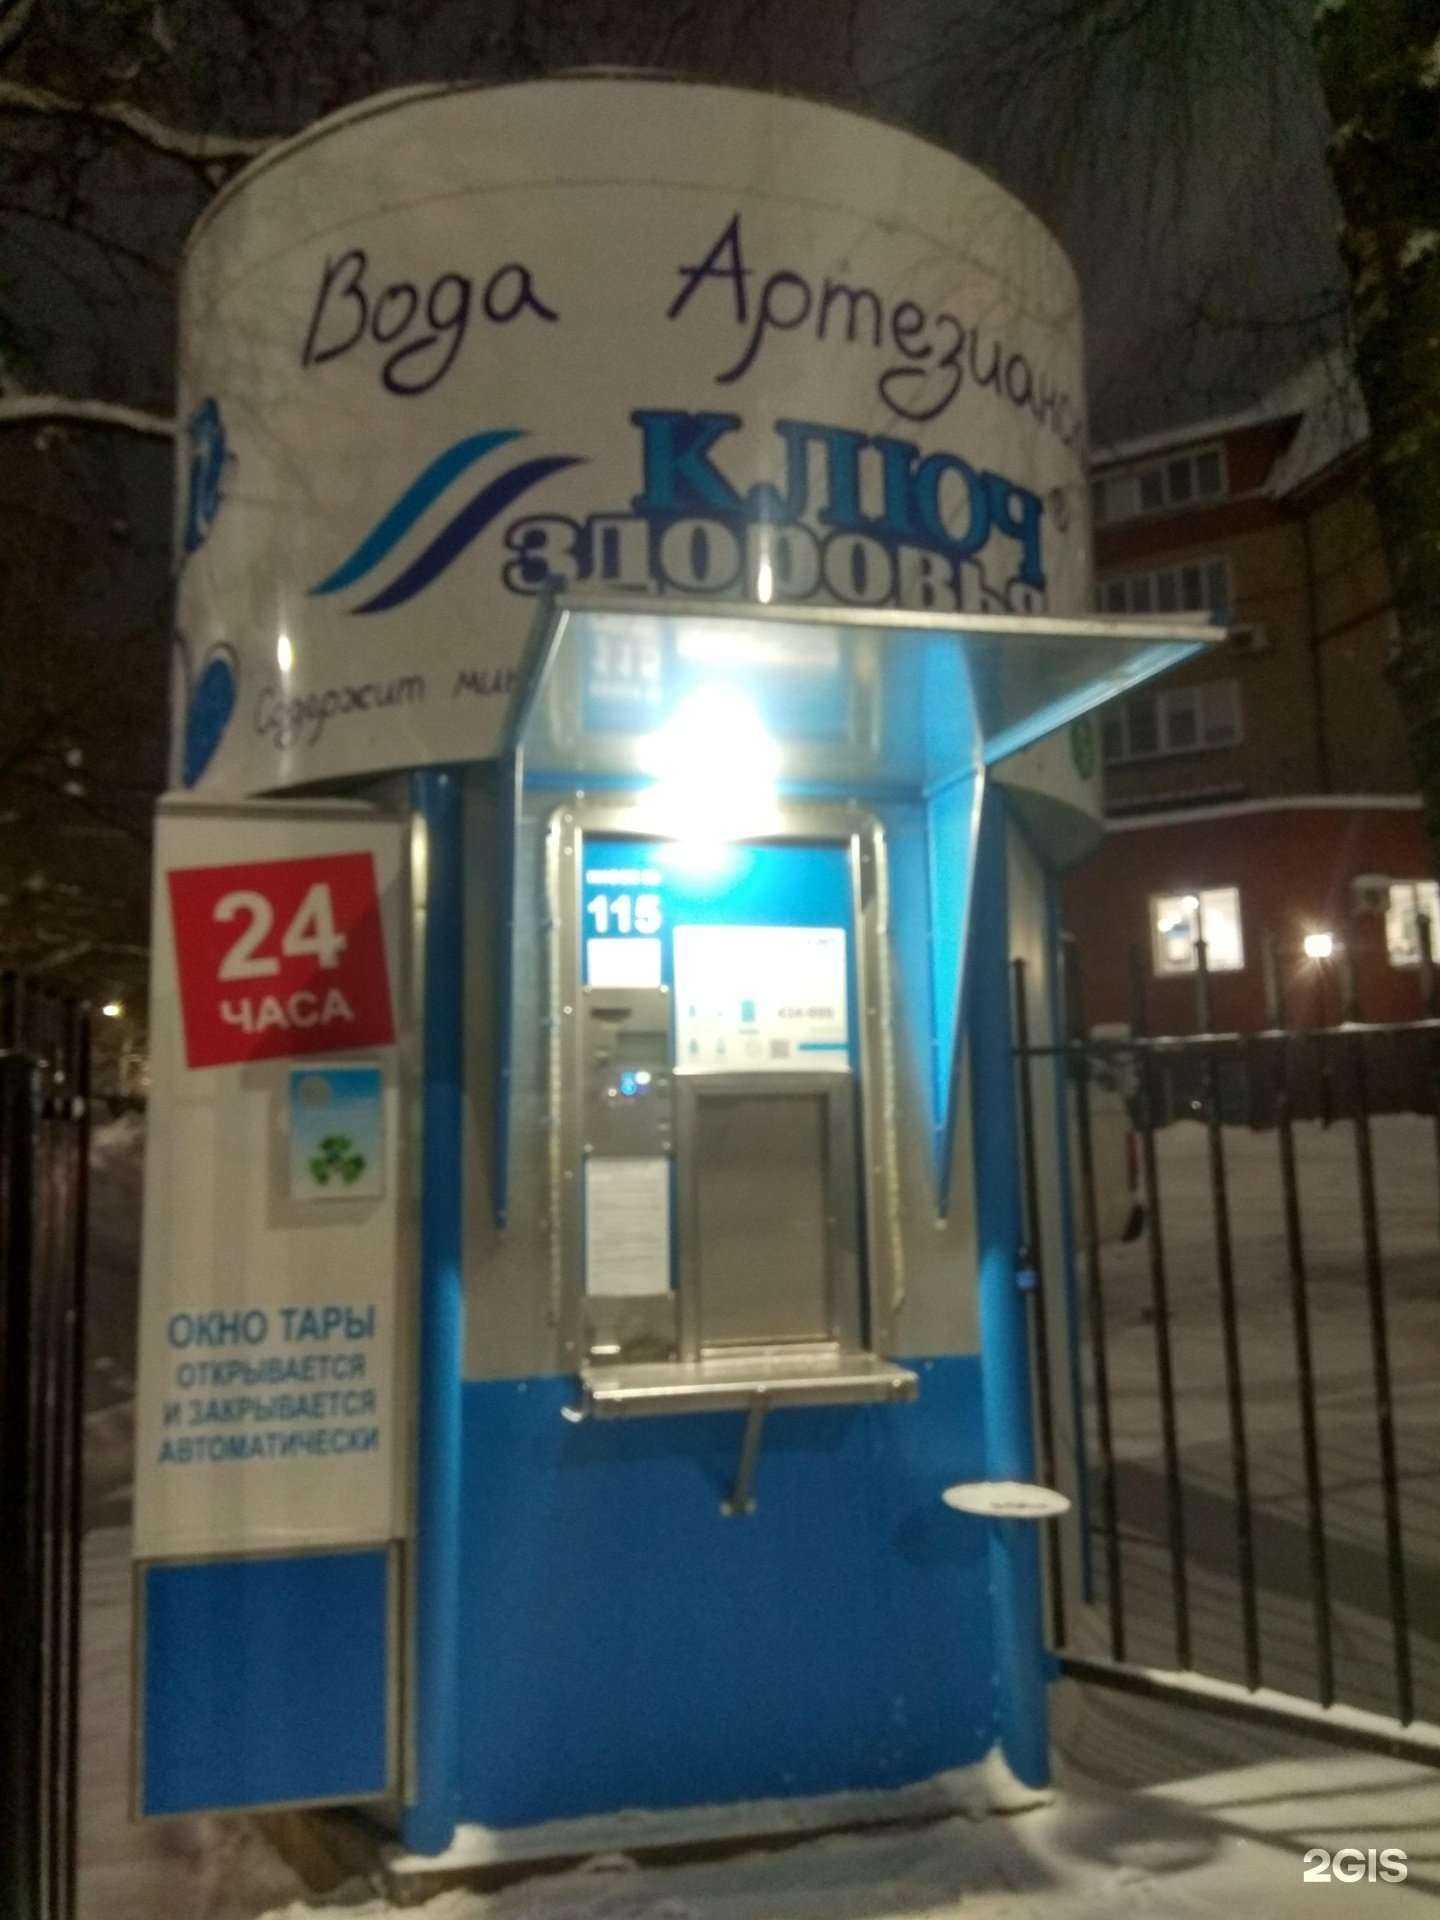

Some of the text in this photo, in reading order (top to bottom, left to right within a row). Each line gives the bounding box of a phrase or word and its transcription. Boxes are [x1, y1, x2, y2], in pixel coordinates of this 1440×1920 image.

[303, 248, 560, 397] Вода
[630, 408, 1046, 588] КЛЮЧ
[213, 882, 349, 983] 24
[587, 893, 663, 934] 115
[219, 988, 355, 1034] ЧАСА
[168, 1304, 376, 1348] ОКНО ТАРЫ
[176, 1353, 367, 1390] ОТКРЫВАЕТСЯ
[163, 1388, 377, 1427] И ЗАКРЫВАЕТСЯ
[158, 1426, 380, 1464] АВТОМАТИЧЕСКИ
